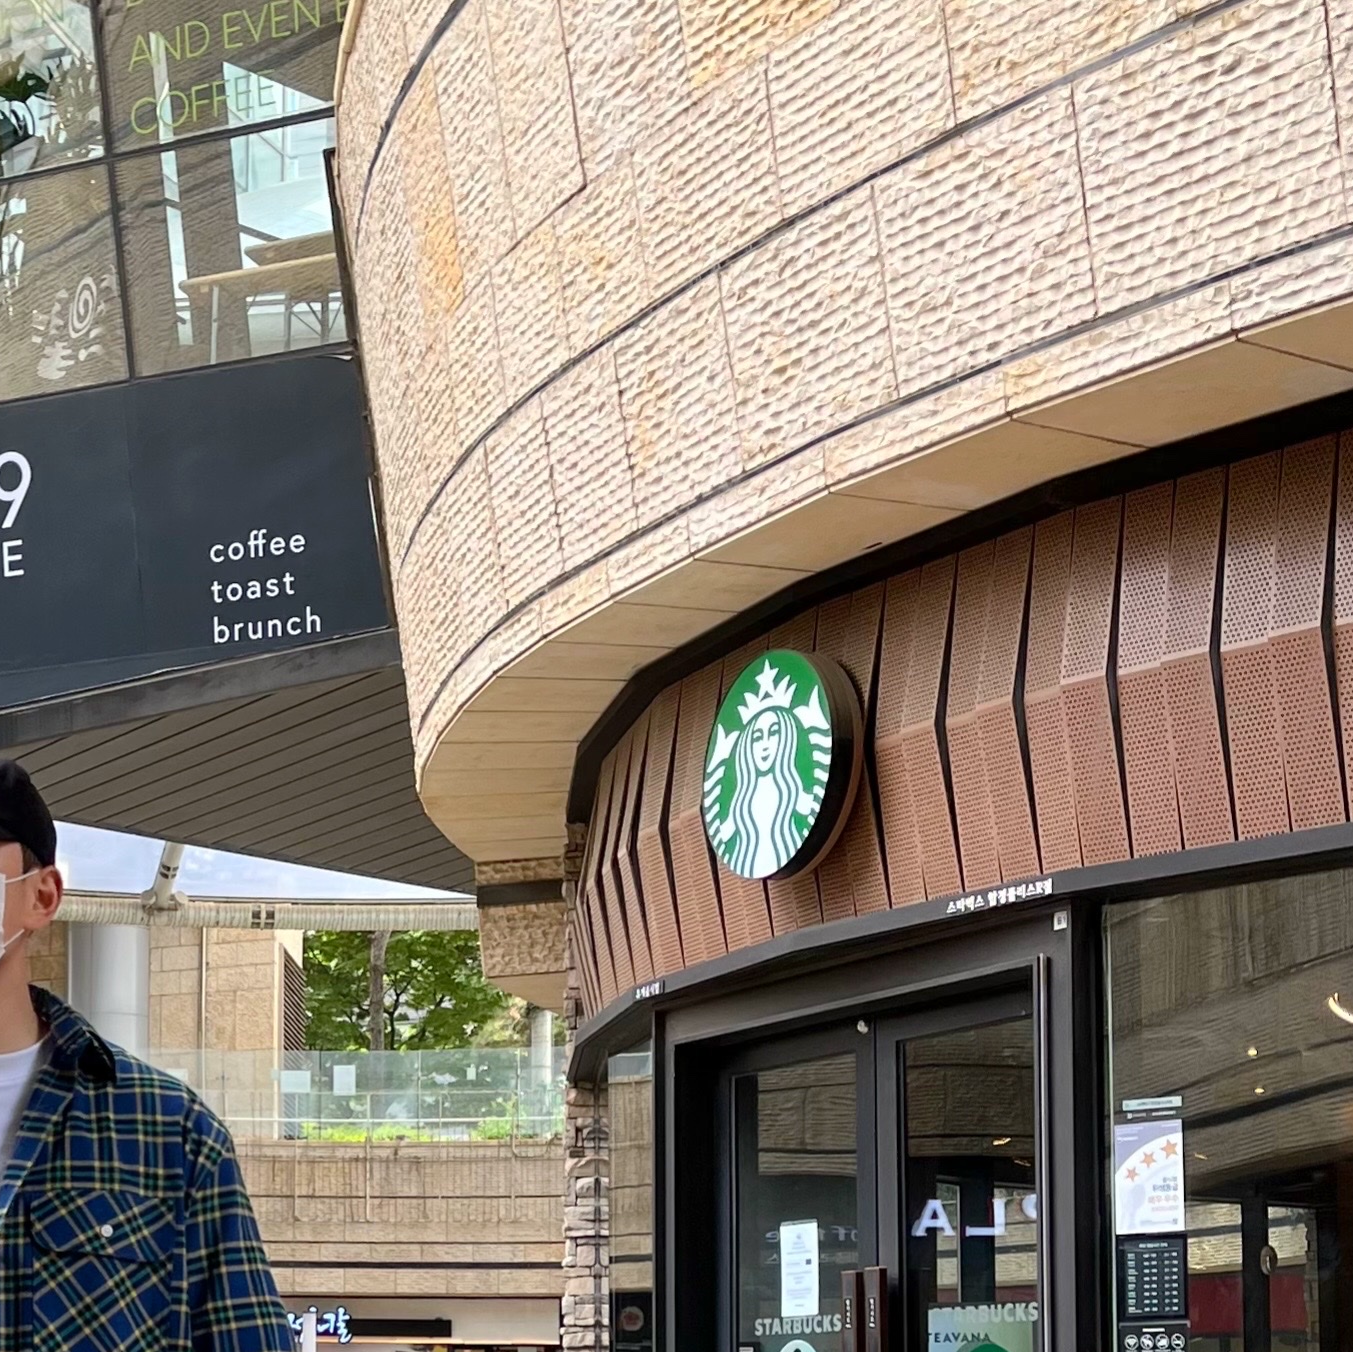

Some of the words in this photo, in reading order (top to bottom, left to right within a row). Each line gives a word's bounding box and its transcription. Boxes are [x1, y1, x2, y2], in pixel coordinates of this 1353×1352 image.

[129, 20, 210, 72] AND
[131, 69, 276, 134] COFFEE
[209, 529, 306, 563] coffee
[211, 571, 295, 603] toast
[212, 607, 322, 644] brunch
[754, 1314, 842, 1336] STARBUCKS
